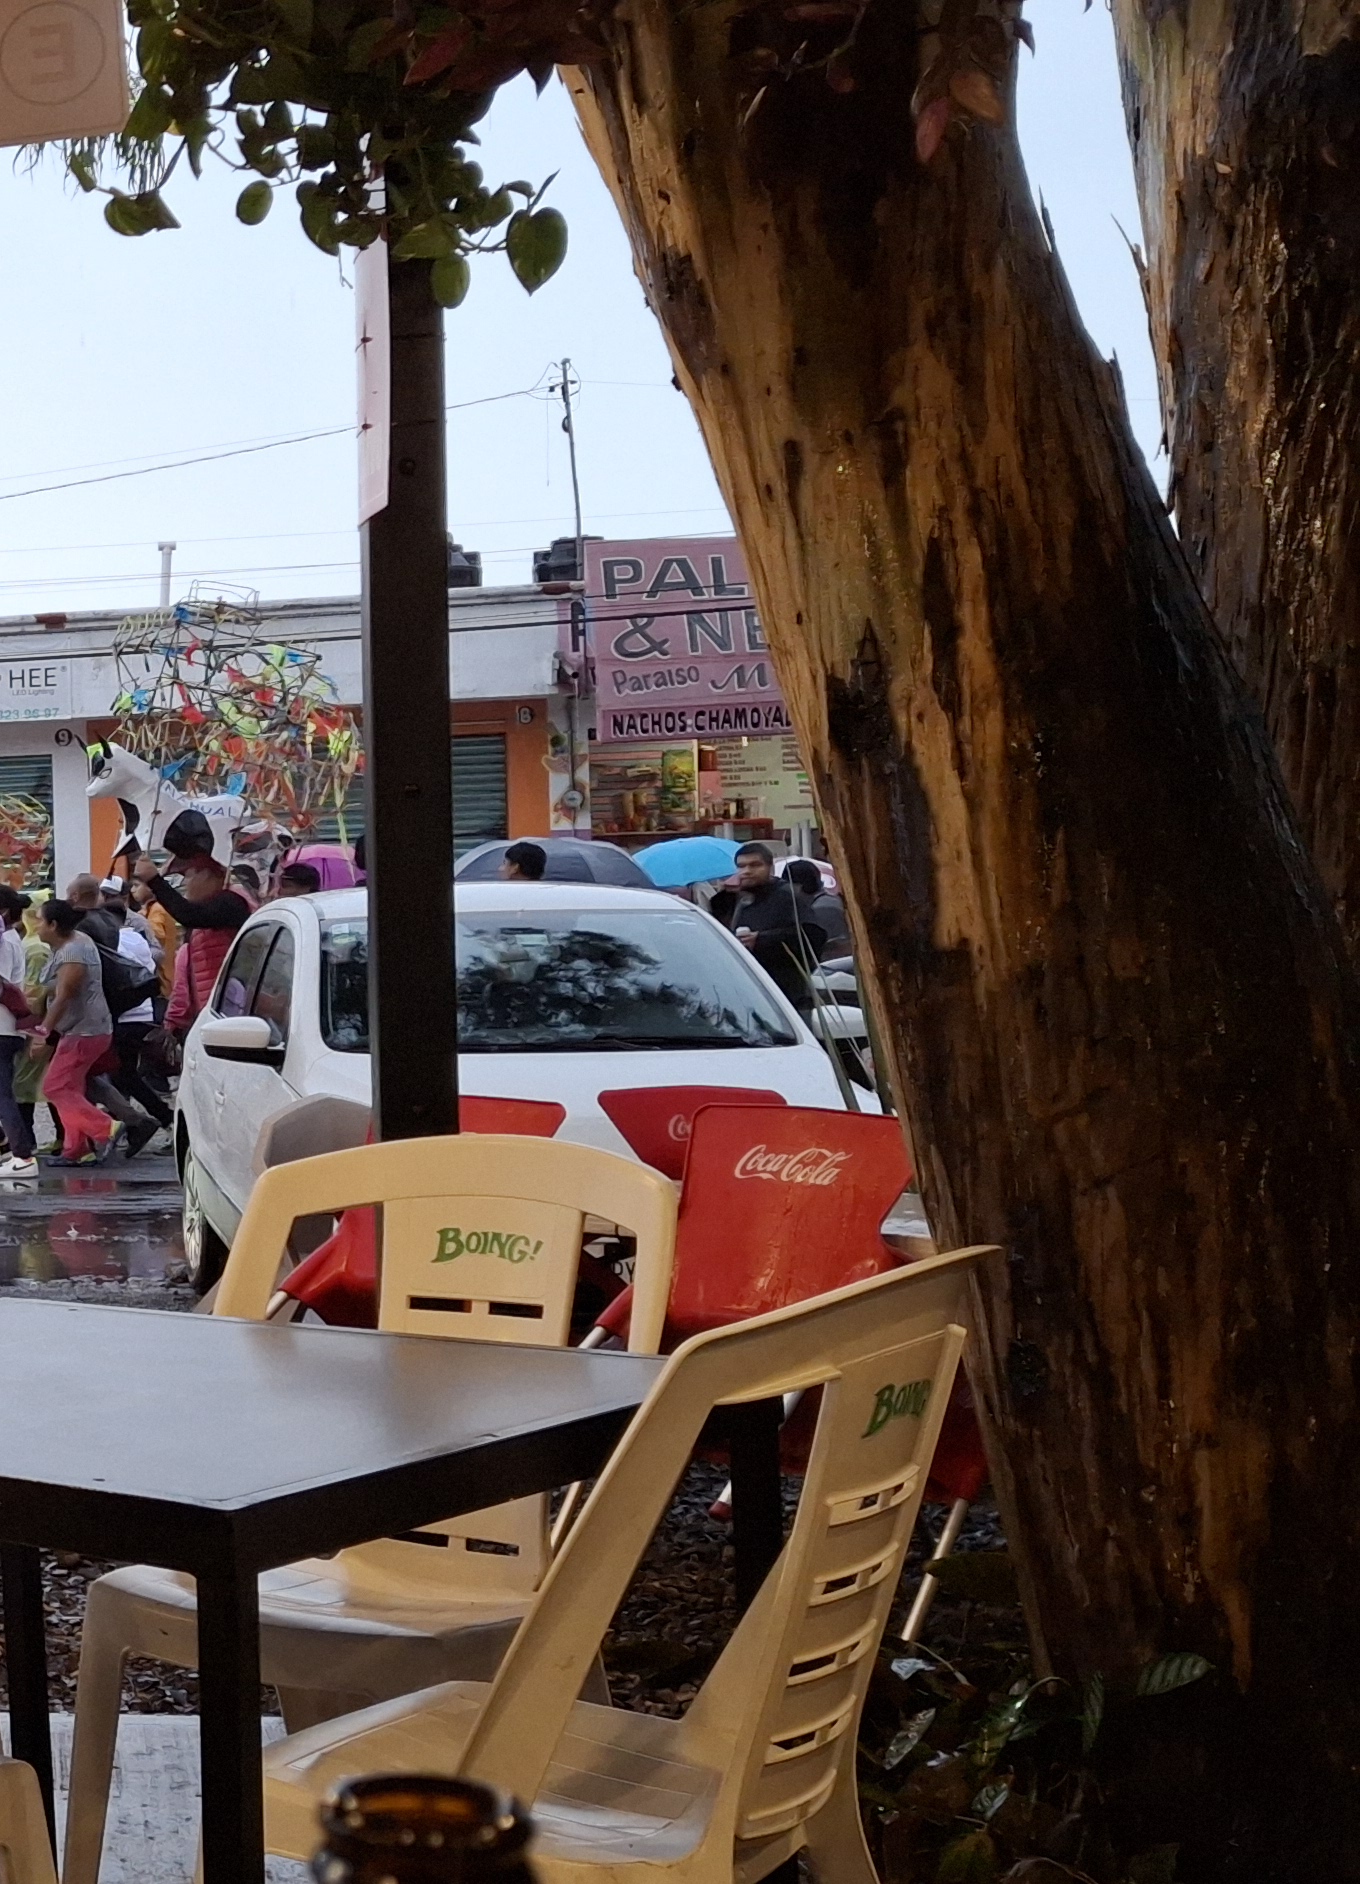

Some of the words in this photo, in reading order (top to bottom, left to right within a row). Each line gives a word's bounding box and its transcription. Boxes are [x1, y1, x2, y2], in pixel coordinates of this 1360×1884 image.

[600, 555, 749, 601] PAL
[684, 606, 768, 655] NE
[9, 667, 57, 689] HEE
[431, 1226, 544, 1264] BOING!
